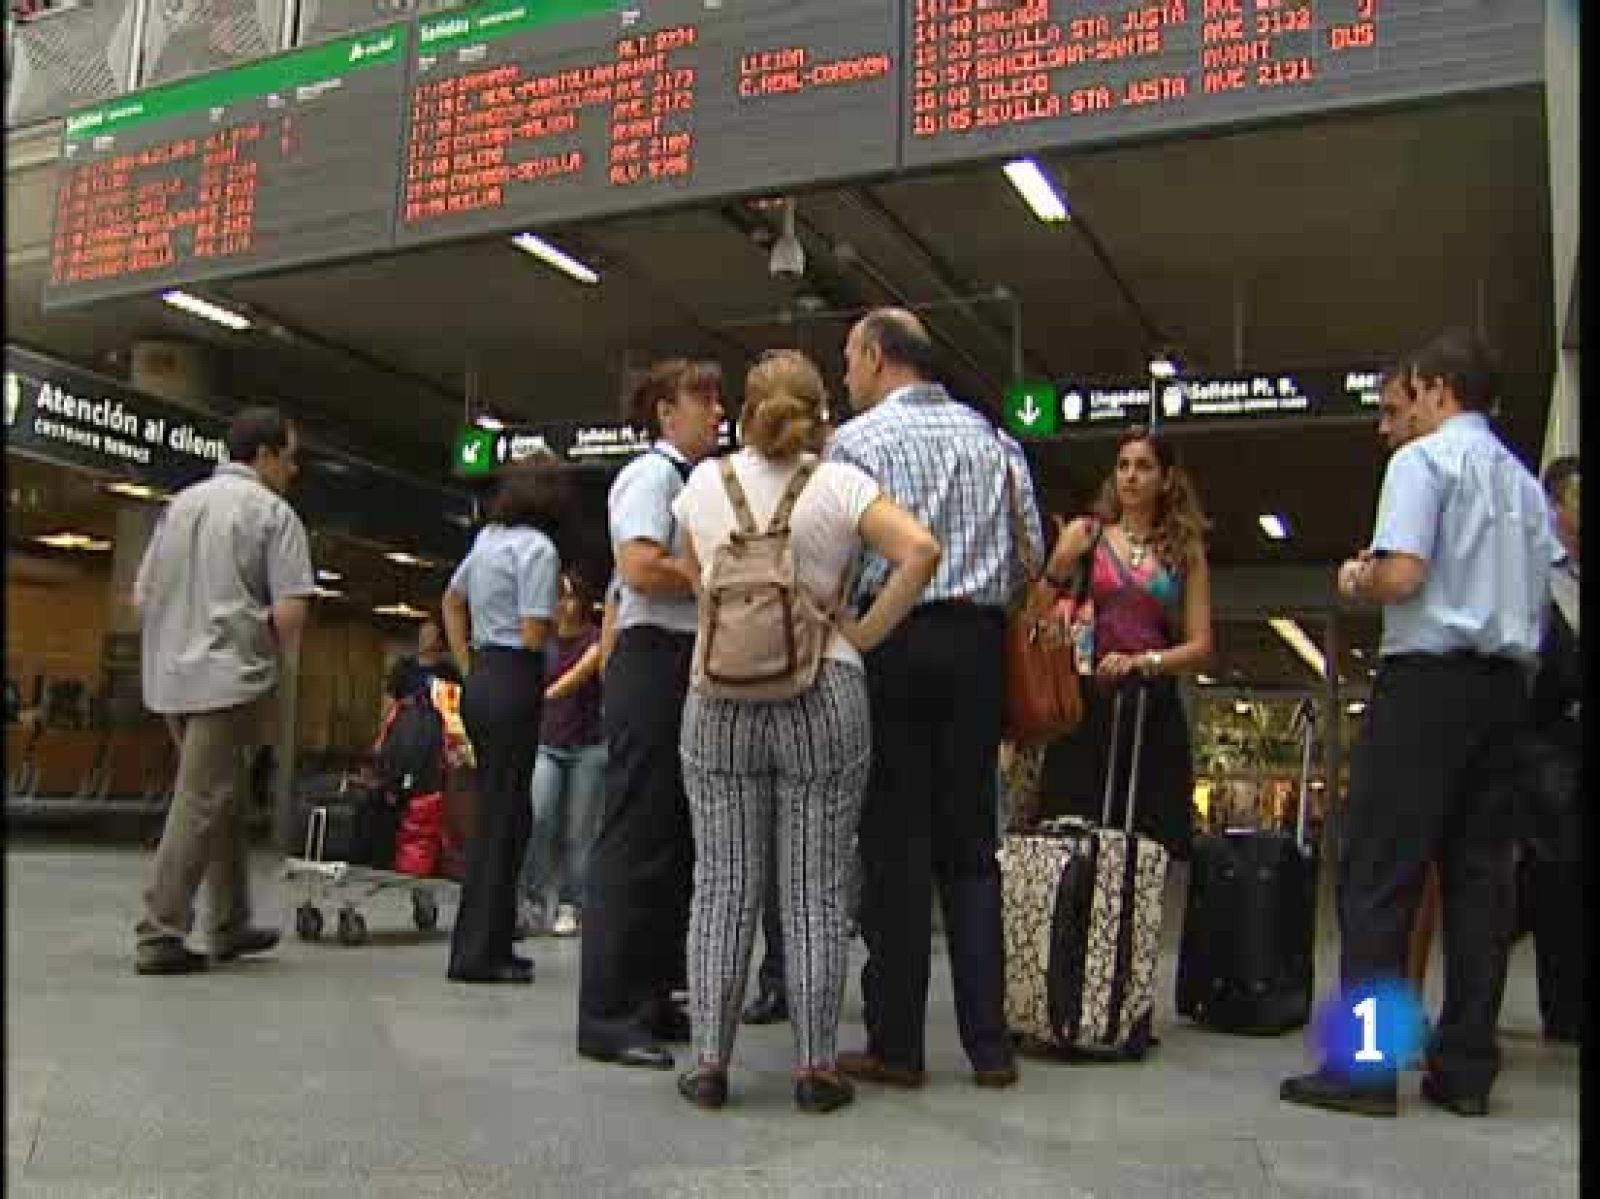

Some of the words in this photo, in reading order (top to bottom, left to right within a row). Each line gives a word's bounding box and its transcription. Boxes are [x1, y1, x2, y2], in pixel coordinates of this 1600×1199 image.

[976, 93, 1061, 127] SEVILLA
[1069, 85, 1111, 114] STA
[37, 381, 138, 437] Atención
[144, 418, 165, 445] al
